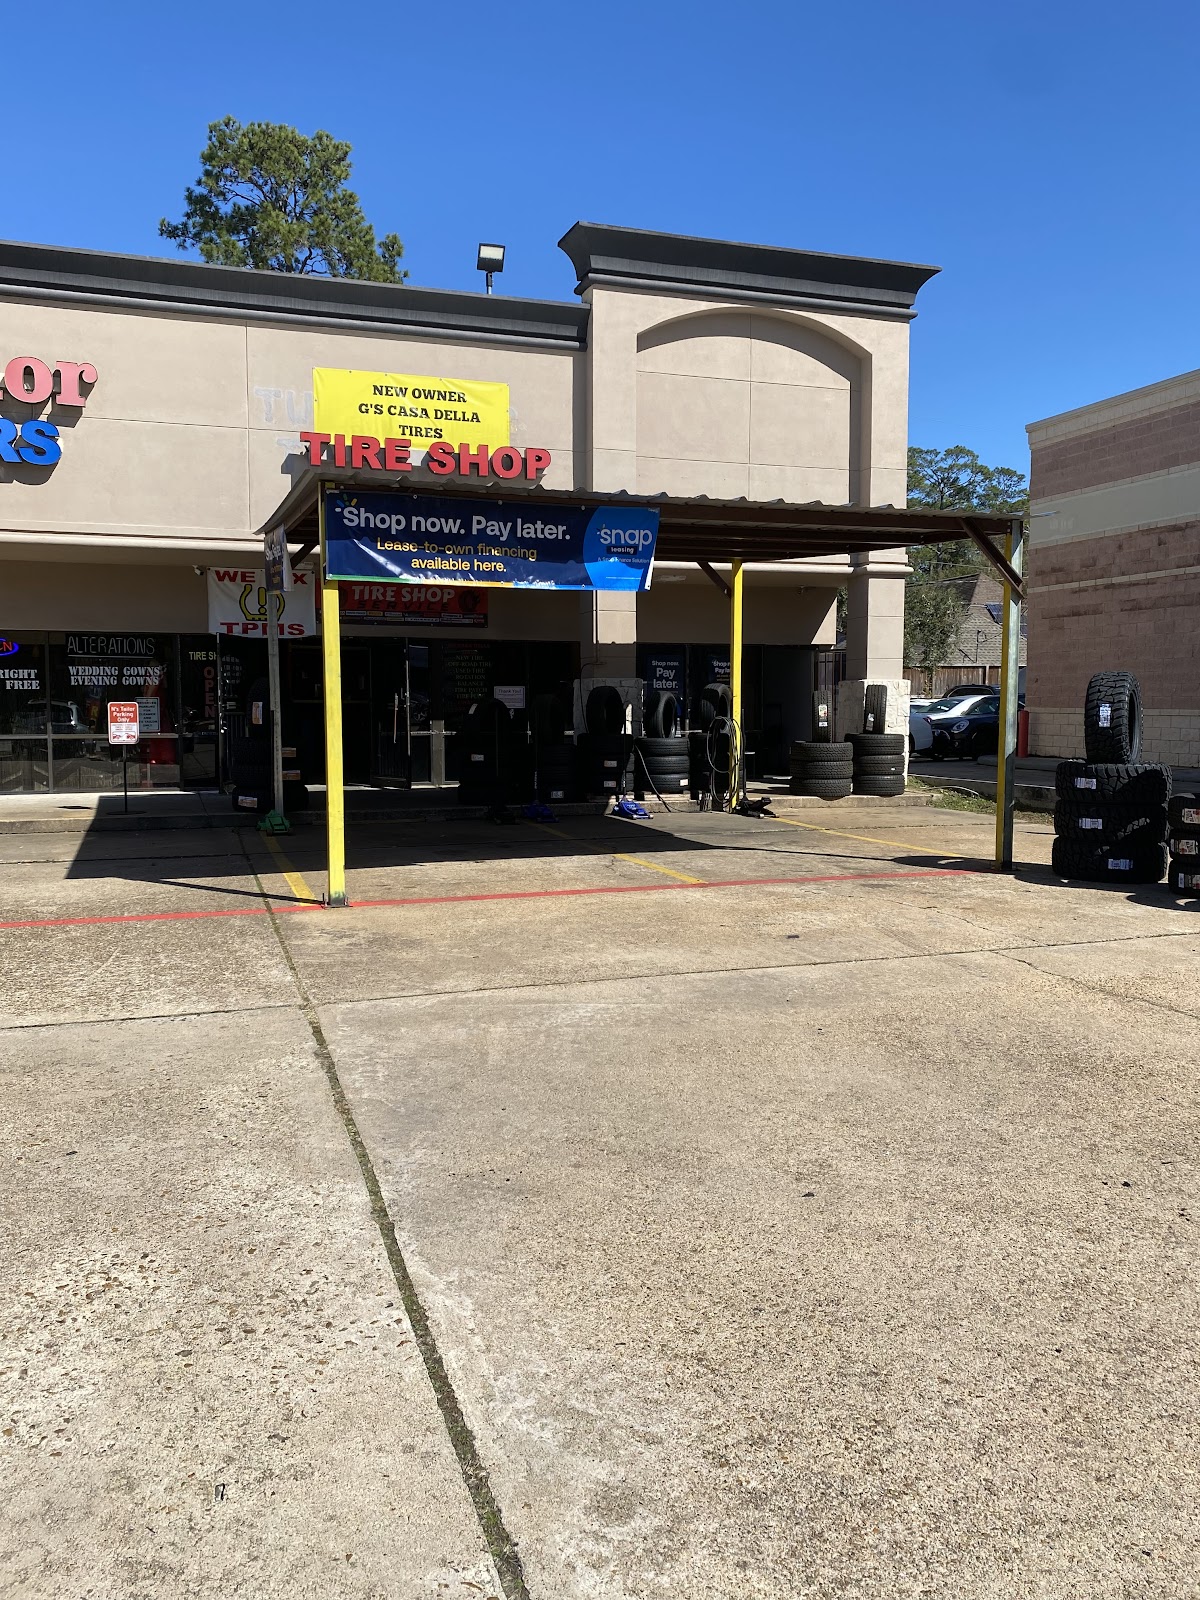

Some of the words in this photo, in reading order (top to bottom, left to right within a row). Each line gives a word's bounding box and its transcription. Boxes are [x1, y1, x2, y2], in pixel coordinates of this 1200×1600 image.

[0, 356, 98, 407] or
[372, 384, 409, 399] NEW
[411, 387, 468, 403] OWNER
[358, 402, 384, 416] G'S
[387, 404, 430, 419] CASA
[434, 408, 481, 423] DELLA
[398, 424, 444, 440] TIRES
[300, 431, 412, 472] TIRE
[427, 441, 552, 481] SHOP
[342, 506, 406, 535] Shop
[411, 511, 466, 535] now.
[471, 514, 512, 539] Pay
[516, 517, 571, 541] later.
[599, 528, 653, 552] snap
[376, 537, 474, 556] Lease-to-own
[477, 542, 537, 562] financing
[611, 546, 635, 554] leasing
[411, 557, 471, 572] available
[473, 559, 507, 573] here.
[214, 570, 256, 583] WE
[352, 585, 396, 601] TIRE
[401, 587, 456, 604] SHOP
[357, 600, 450, 612] SERVICE
[67, 636, 156, 655] ALTERATIONS
[189, 651, 207, 661] TIRE
[68, 665, 118, 676] WEDDING
[123, 666, 161, 676] GOWNS
[656, 667, 675, 680] Pay
[5, 680, 40, 690] FREE
[70, 676, 118, 686] EVENING
[121, 676, 160, 686] GOWNS
[653, 678, 679, 689] later.
[202, 665, 216, 718] OPEN
